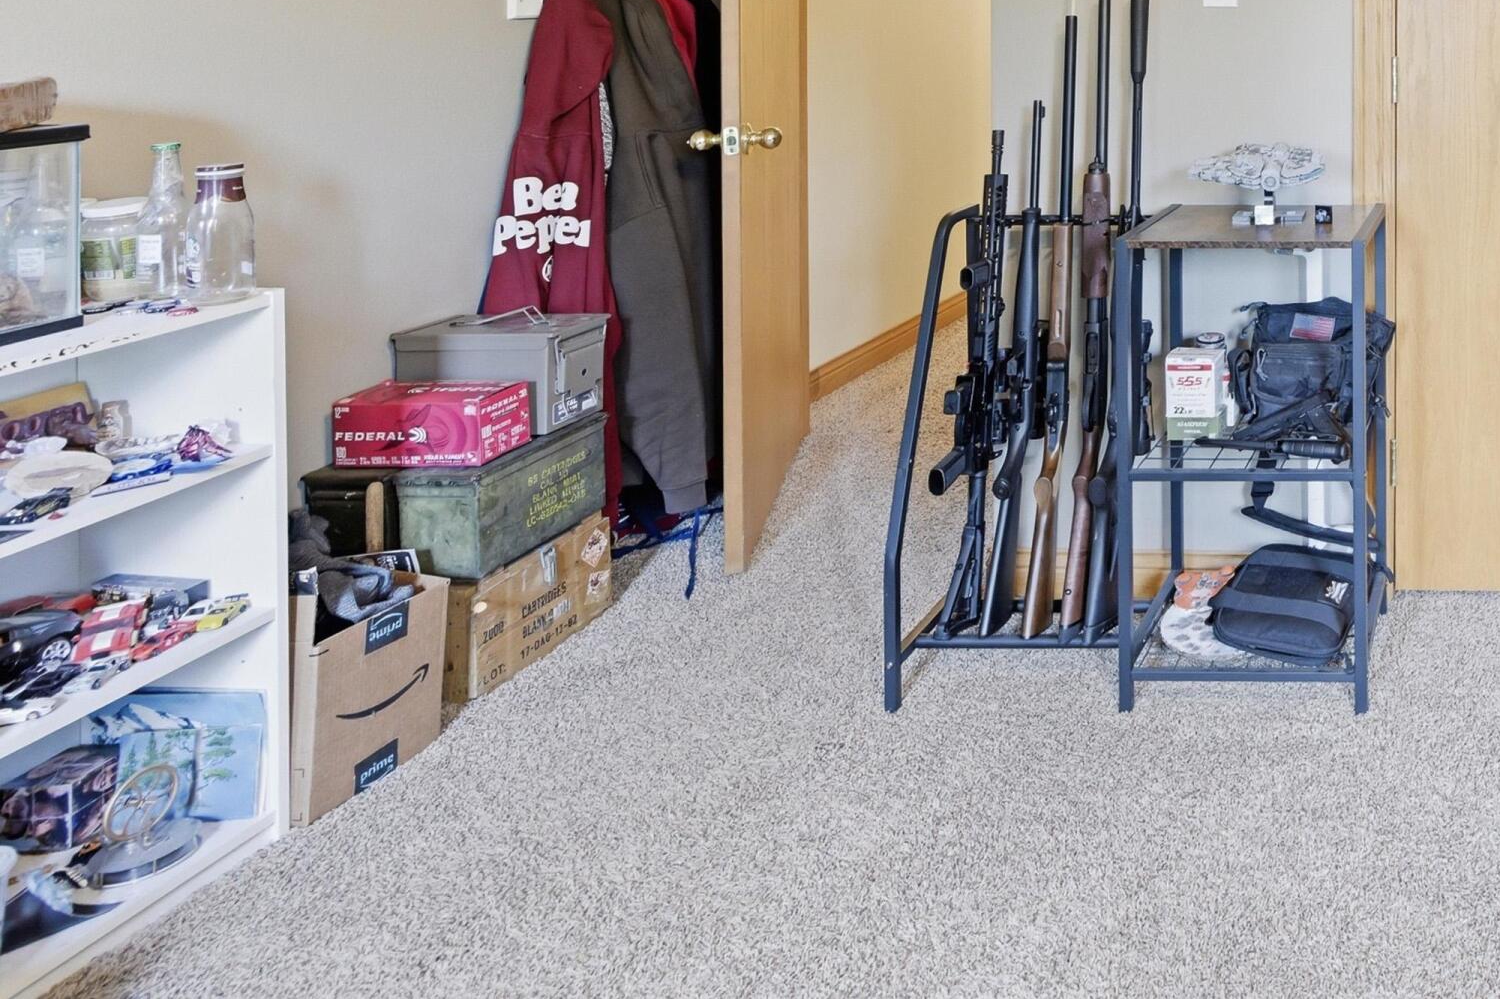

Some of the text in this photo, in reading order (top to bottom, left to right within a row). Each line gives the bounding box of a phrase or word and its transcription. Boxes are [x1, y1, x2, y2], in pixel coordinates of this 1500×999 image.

[334, 431, 406, 442] FEDERAL
[368, 615, 403, 642] prime
[360, 752, 394, 785] prime
